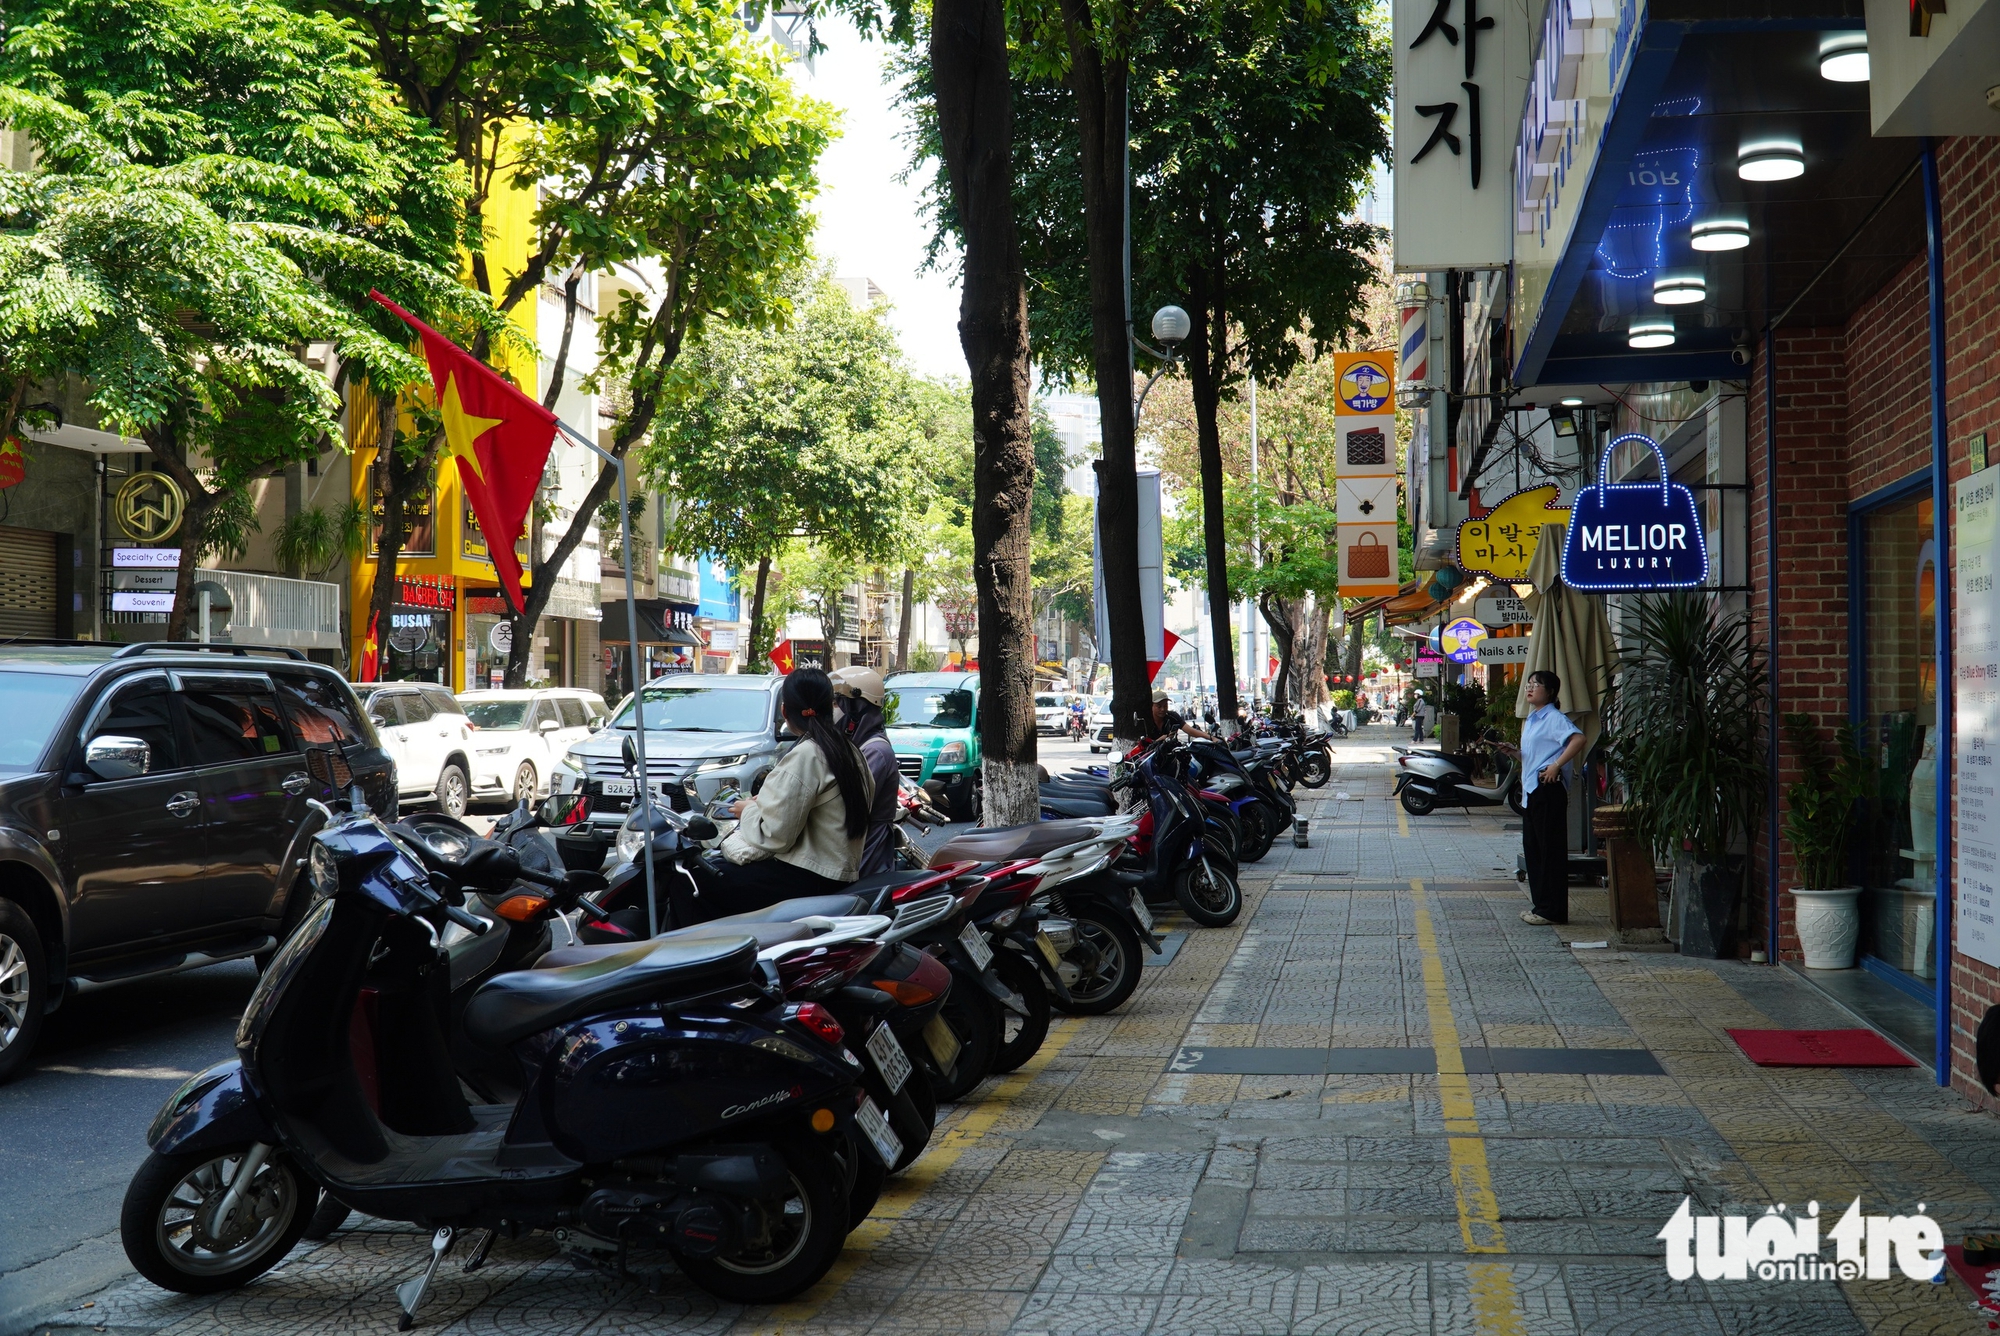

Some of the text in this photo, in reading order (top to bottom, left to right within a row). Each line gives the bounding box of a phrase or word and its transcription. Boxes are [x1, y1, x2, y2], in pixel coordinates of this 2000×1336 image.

[1581, 523, 1687, 551] MELIOR
[117, 553, 153, 562] Specialty
[1475, 543, 1534, 564] 마사
[1597, 556, 1673, 570] LUXURY
[135, 575, 163, 584] Dessert
[132, 598, 166, 606] Souvenir
[403, 585, 438, 606] BARBER
[392, 614, 431, 627] BUSAN
[1479, 646, 1504, 657] Nails
[1507, 646, 1515, 655] &
[1967, 665, 1975, 679] Blue
[1976, 664, 1986, 681] Story
[871, 1028, 896, 1065] 43-AC
[883, 1048, 911, 1090] 085.56
